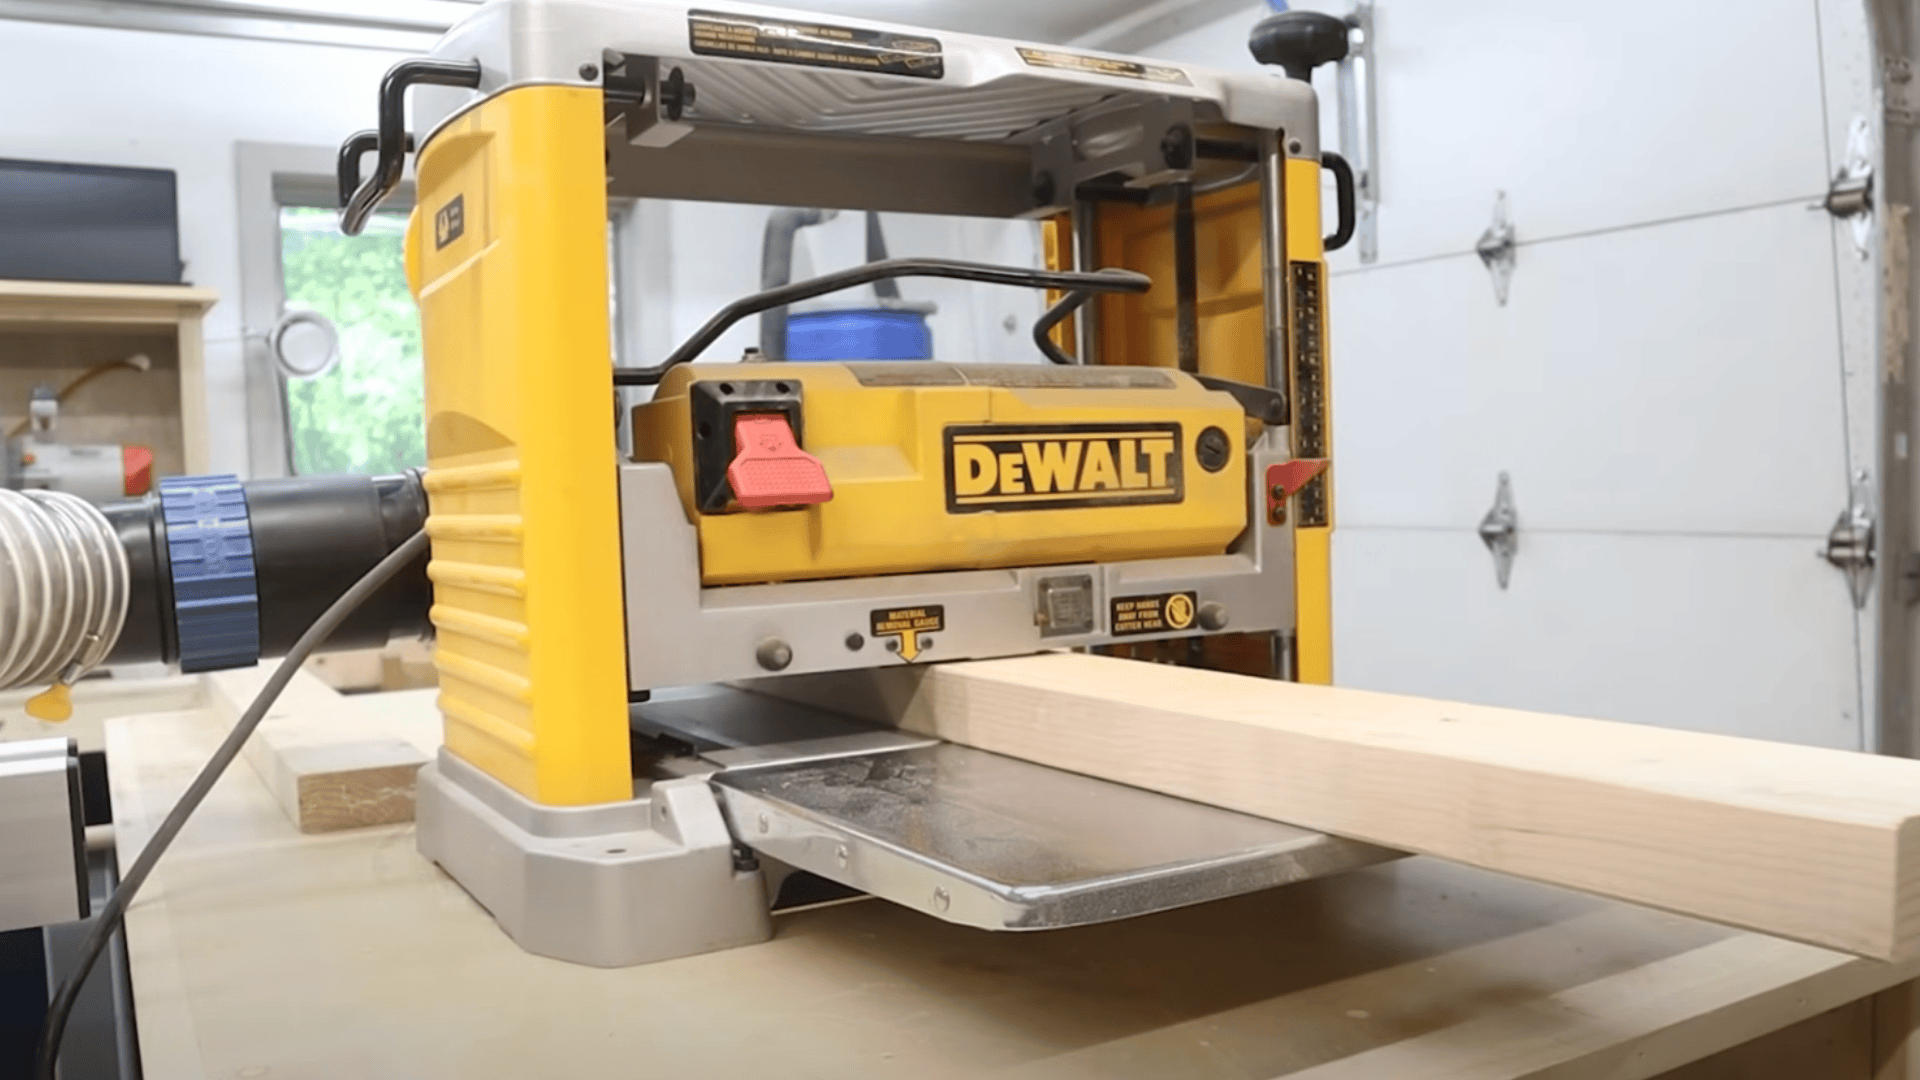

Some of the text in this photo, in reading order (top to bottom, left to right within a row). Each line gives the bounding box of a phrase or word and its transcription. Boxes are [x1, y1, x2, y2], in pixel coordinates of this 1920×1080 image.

[1116, 600, 1160, 611] KEEP HANDS
[888, 609, 926, 620] MATERIAL
[1118, 610, 1159, 621] AWAY FROM
[876, 616, 939, 630] REMOVAL GAUGE
[1115, 619, 1163, 632] CUTTER HEAD
